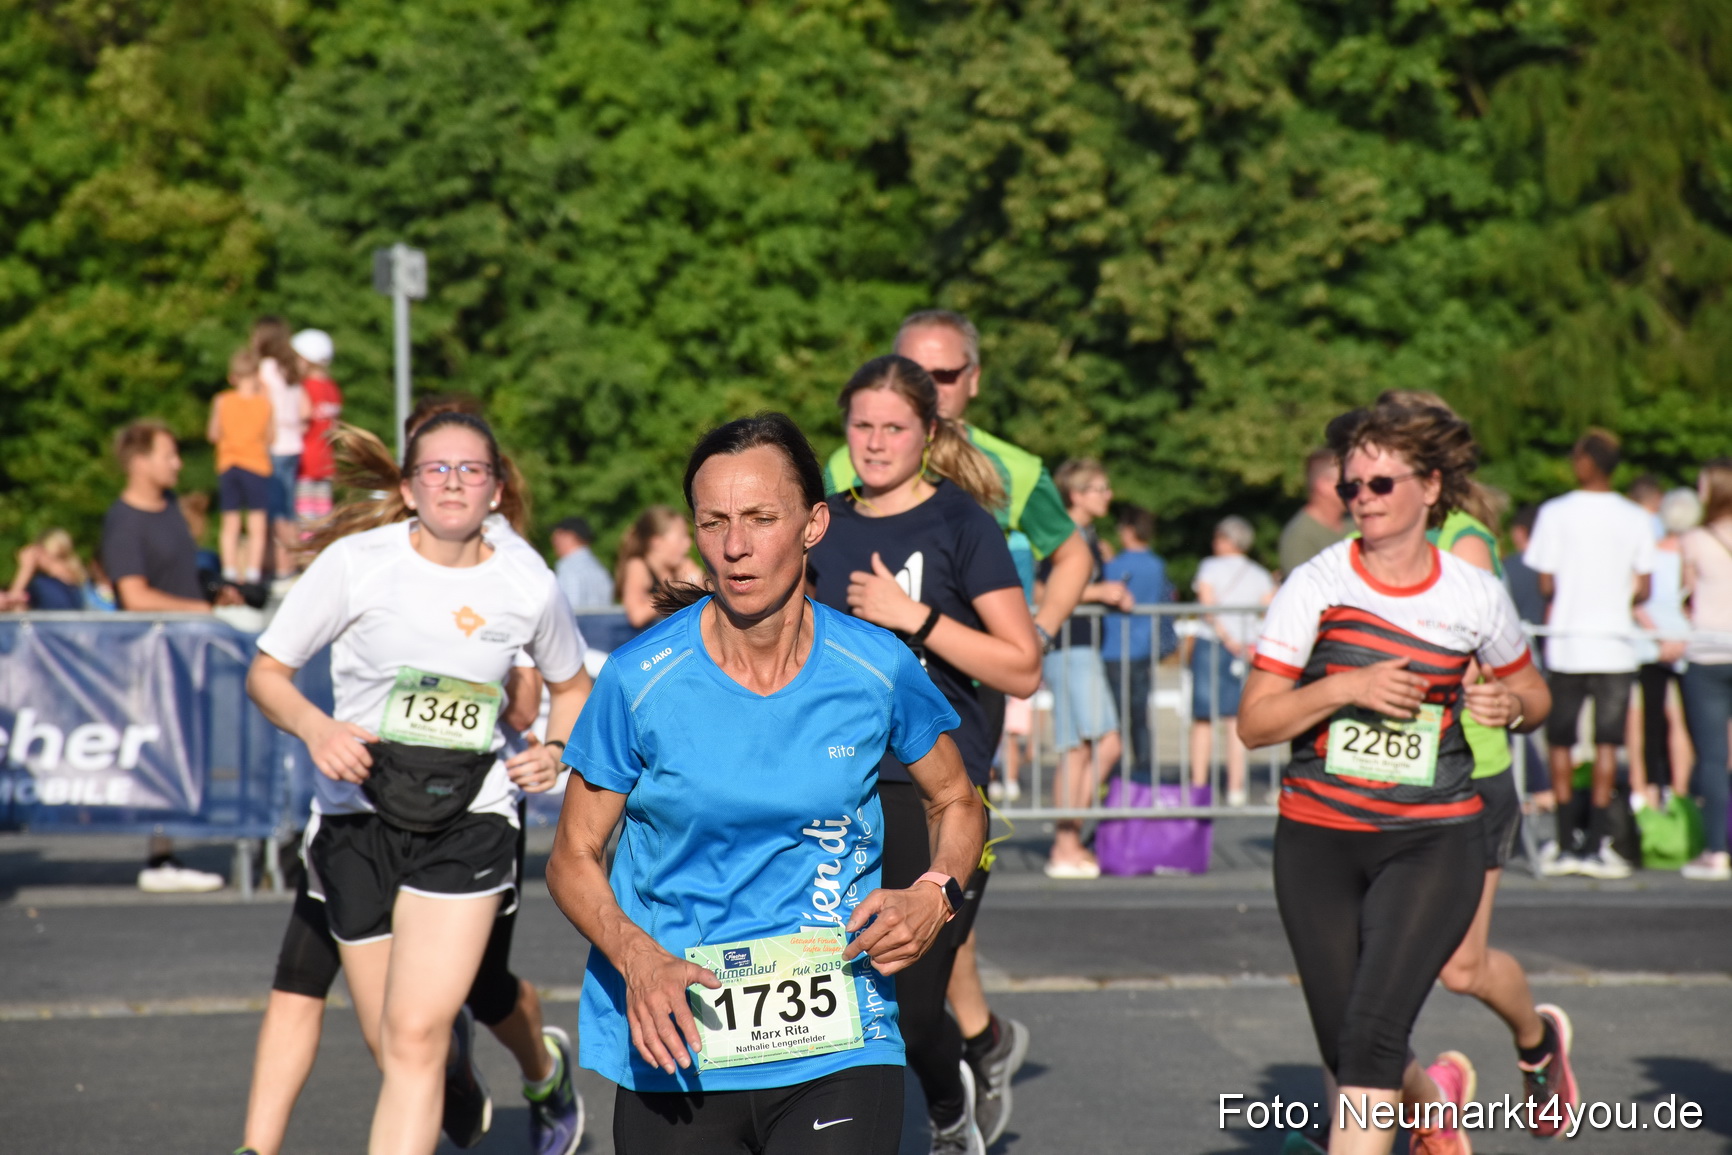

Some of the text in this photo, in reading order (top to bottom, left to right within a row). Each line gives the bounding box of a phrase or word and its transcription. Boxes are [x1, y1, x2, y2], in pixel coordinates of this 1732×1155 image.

[651, 647, 673, 665] JAKO
[402, 693, 480, 730] 1348
[1342, 726, 1422, 760] 2268
[828, 745, 855, 760] Rita
[814, 960, 842, 974] 2019
[714, 974, 837, 1031] 1735
[750, 1024, 809, 1042] Marx Rita
[736, 1041, 770, 1053] Nathalie
[772, 1035, 826, 1049] Lengenfelder
